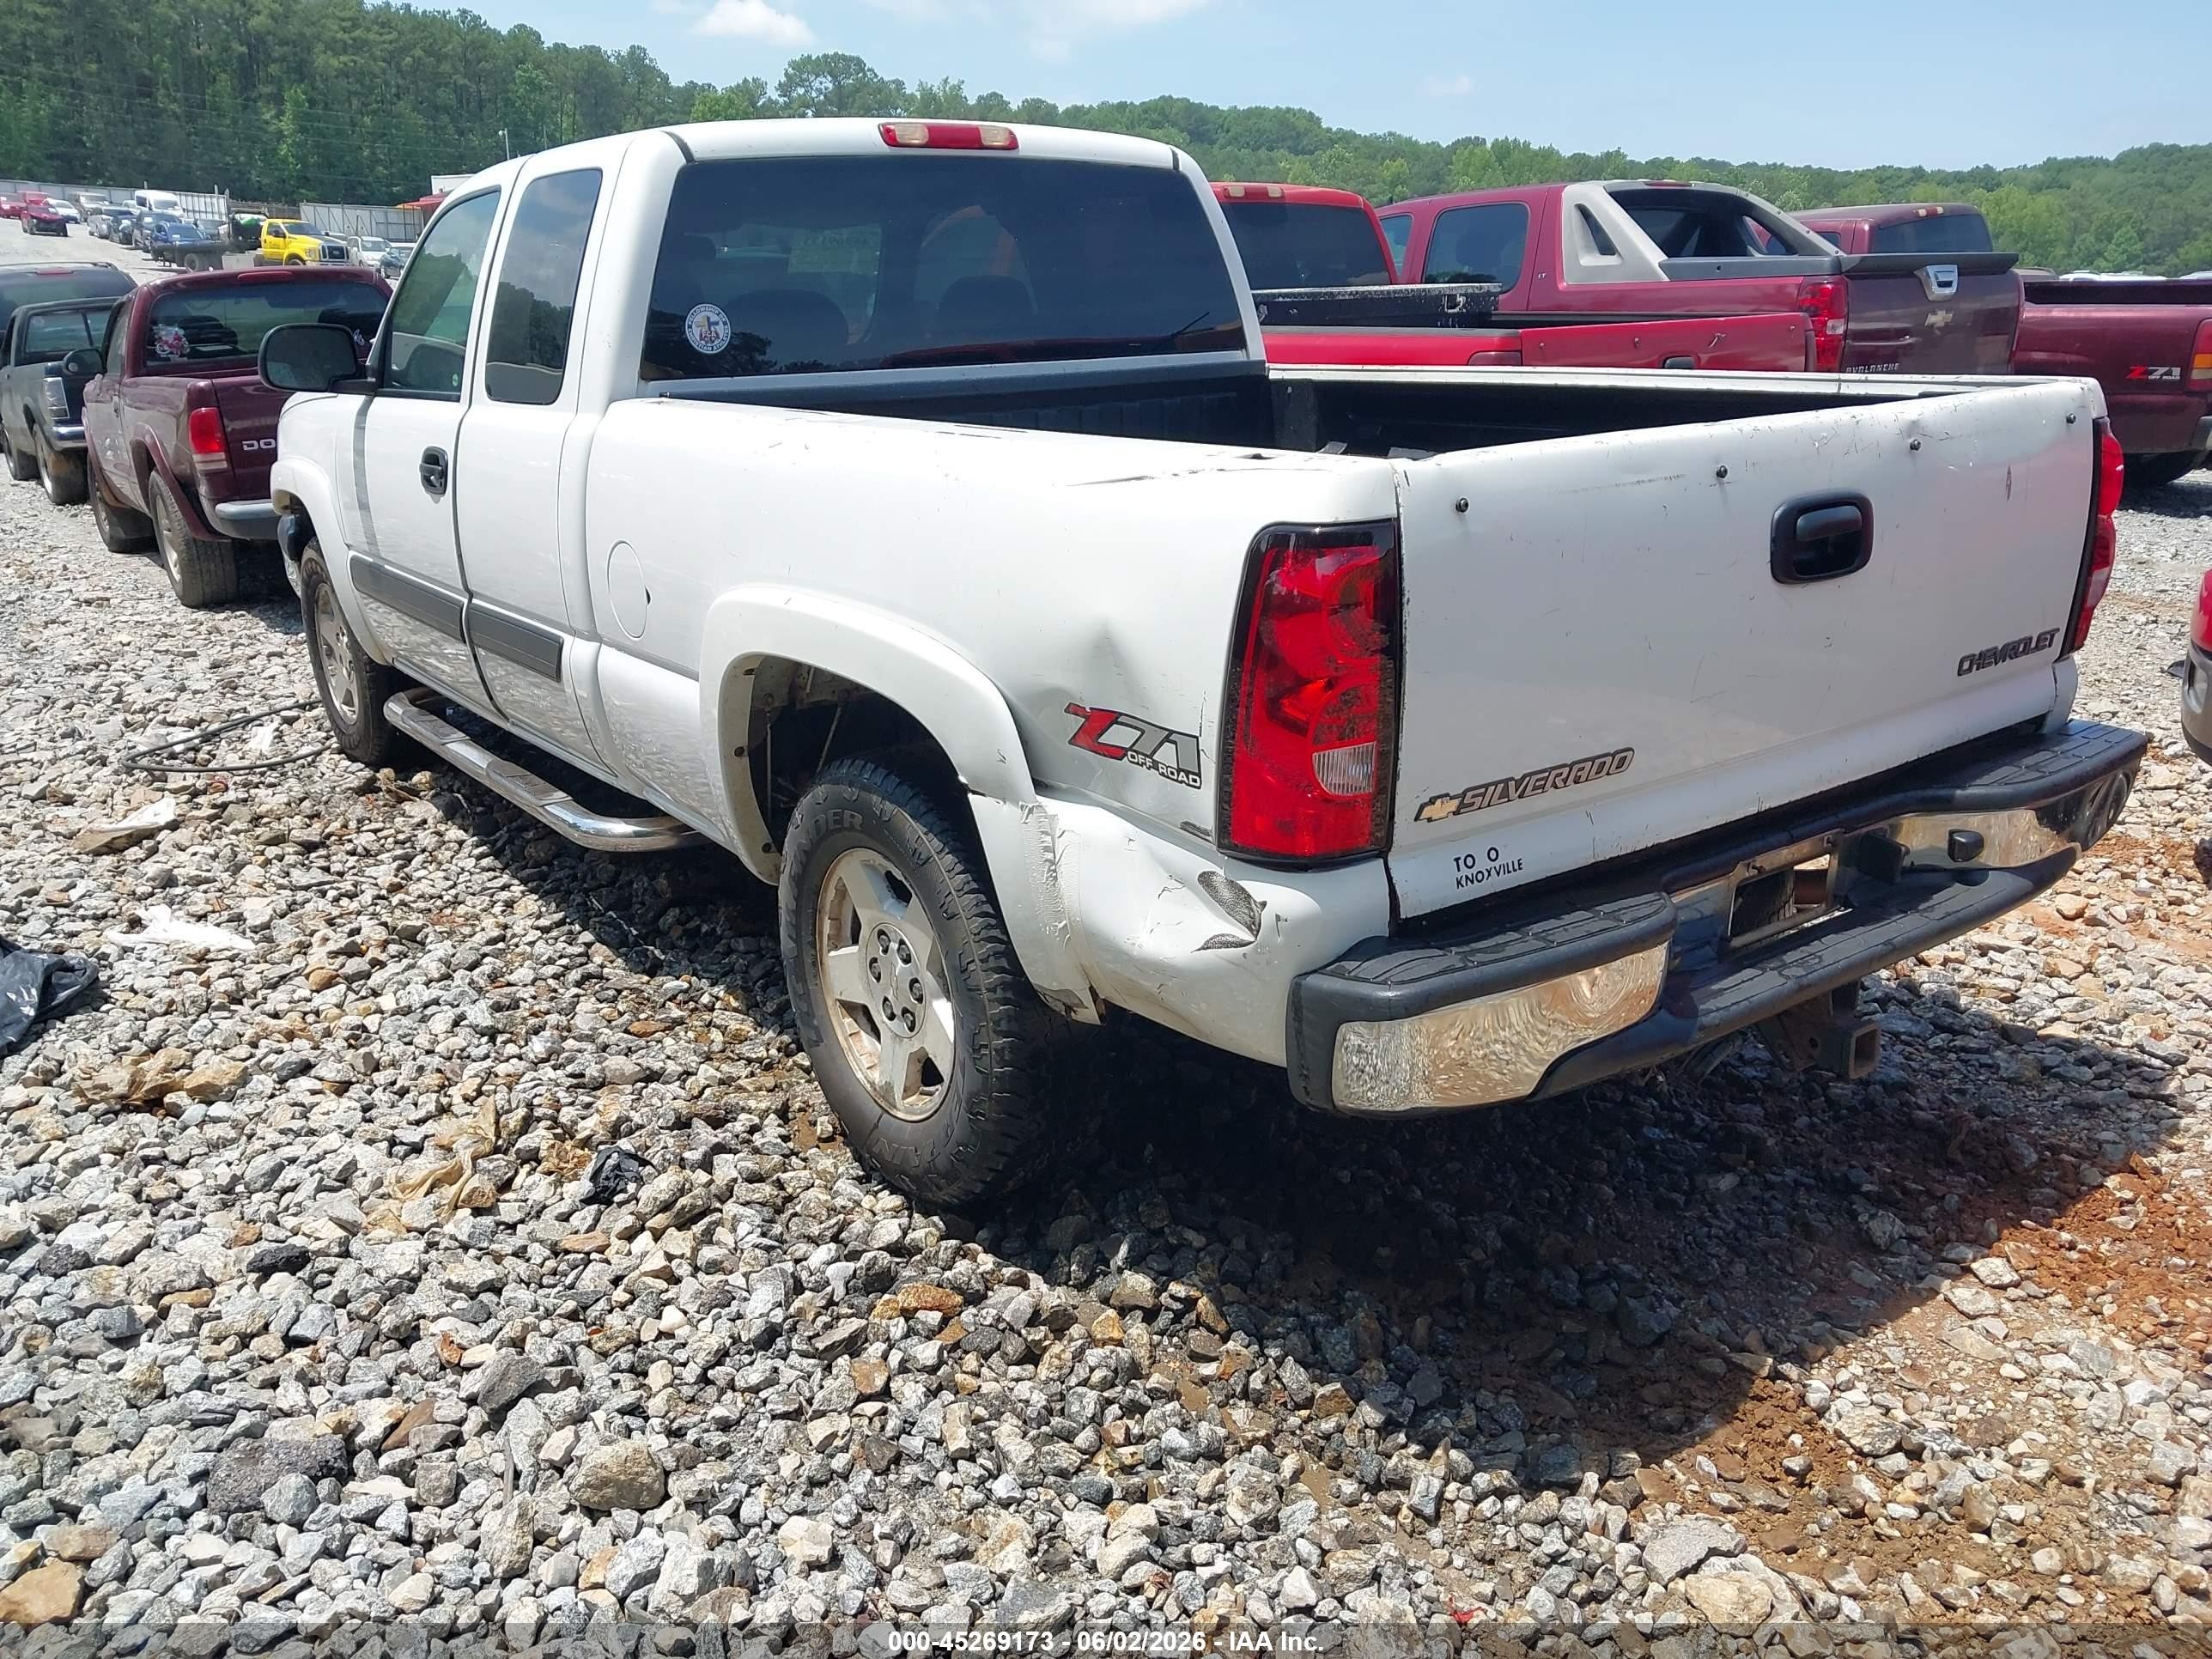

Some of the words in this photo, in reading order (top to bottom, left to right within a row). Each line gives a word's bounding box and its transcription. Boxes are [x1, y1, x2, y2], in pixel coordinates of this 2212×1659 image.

[688, 306, 720, 325] FELLOWSHIP
[688, 328, 712, 351] CHRISTIAN
[1845, 362, 1900, 374] AVALANCHE
[2125, 366, 2181, 379] Z71
[1957, 628, 2060, 677] CHEVROLET
[1064, 702, 1201, 775] Z71
[1127, 750, 1153, 769] OFF
[1158, 763, 1201, 787] ROAD
[1455, 748, 1635, 815] SILVERADO
[1455, 859, 1523, 890] KNOXVILLE
